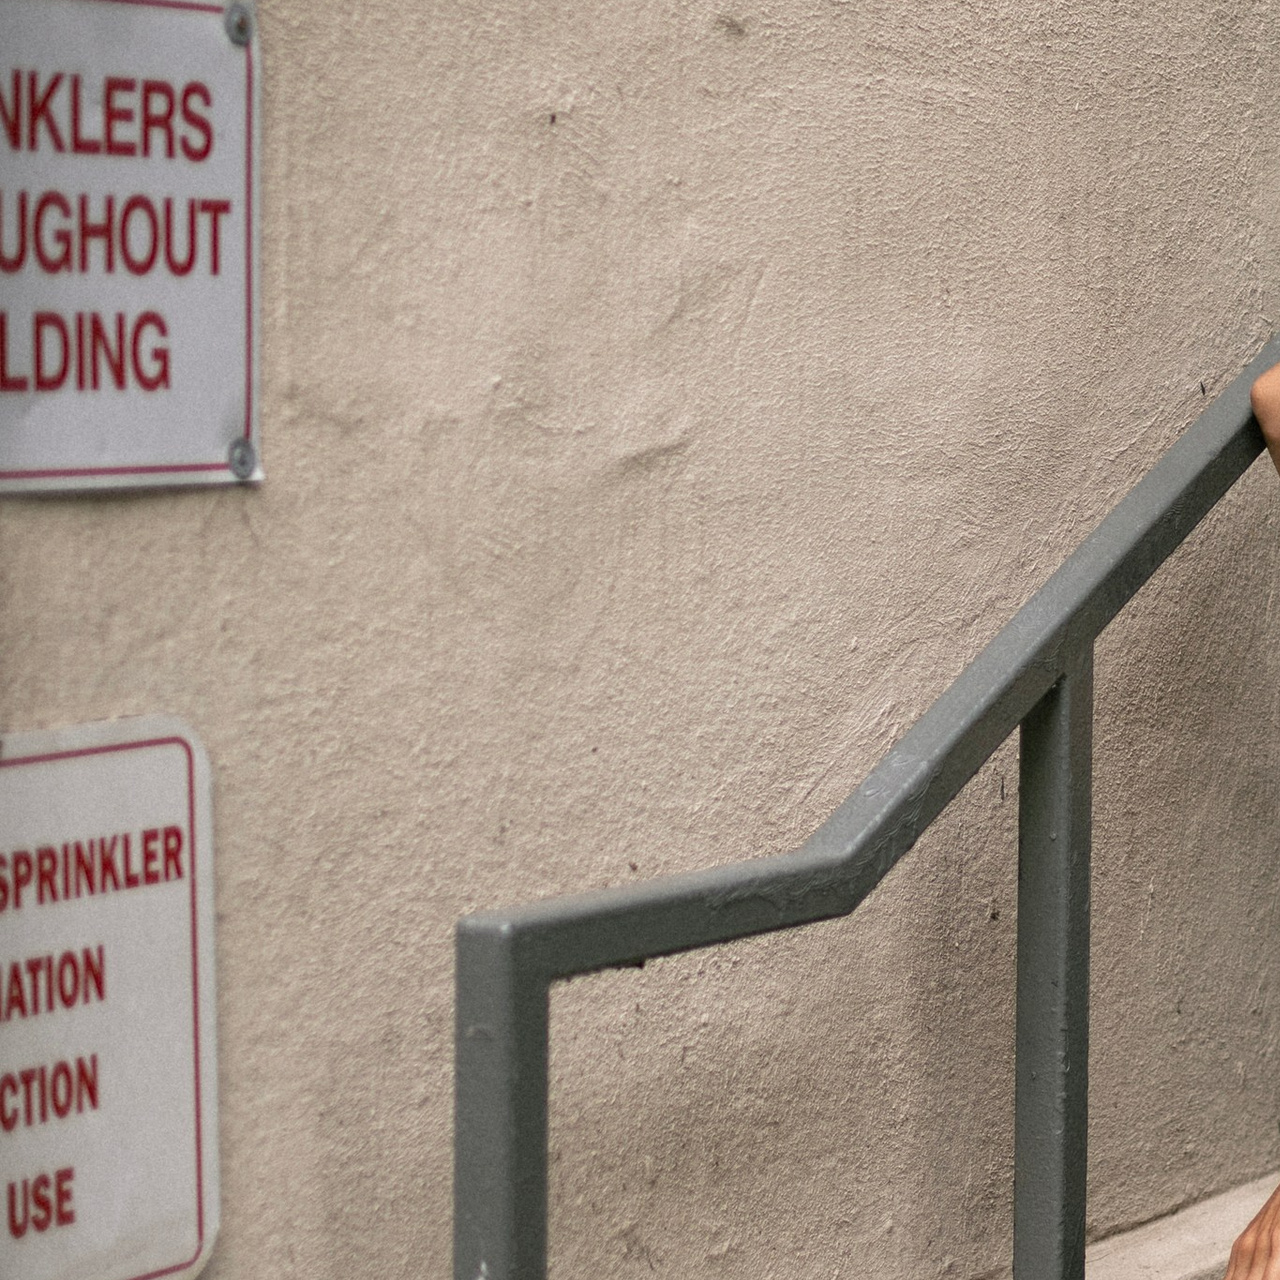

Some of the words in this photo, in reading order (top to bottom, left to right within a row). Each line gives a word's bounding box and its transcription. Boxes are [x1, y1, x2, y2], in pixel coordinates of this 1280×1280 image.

[0, 191, 232, 277] UGHOUT
[0, 311, 171, 392] LDING
[0, 945, 106, 1022] ATION
[0, 1054, 99, 1133] CTION
[7, 1166, 76, 1239] USE
